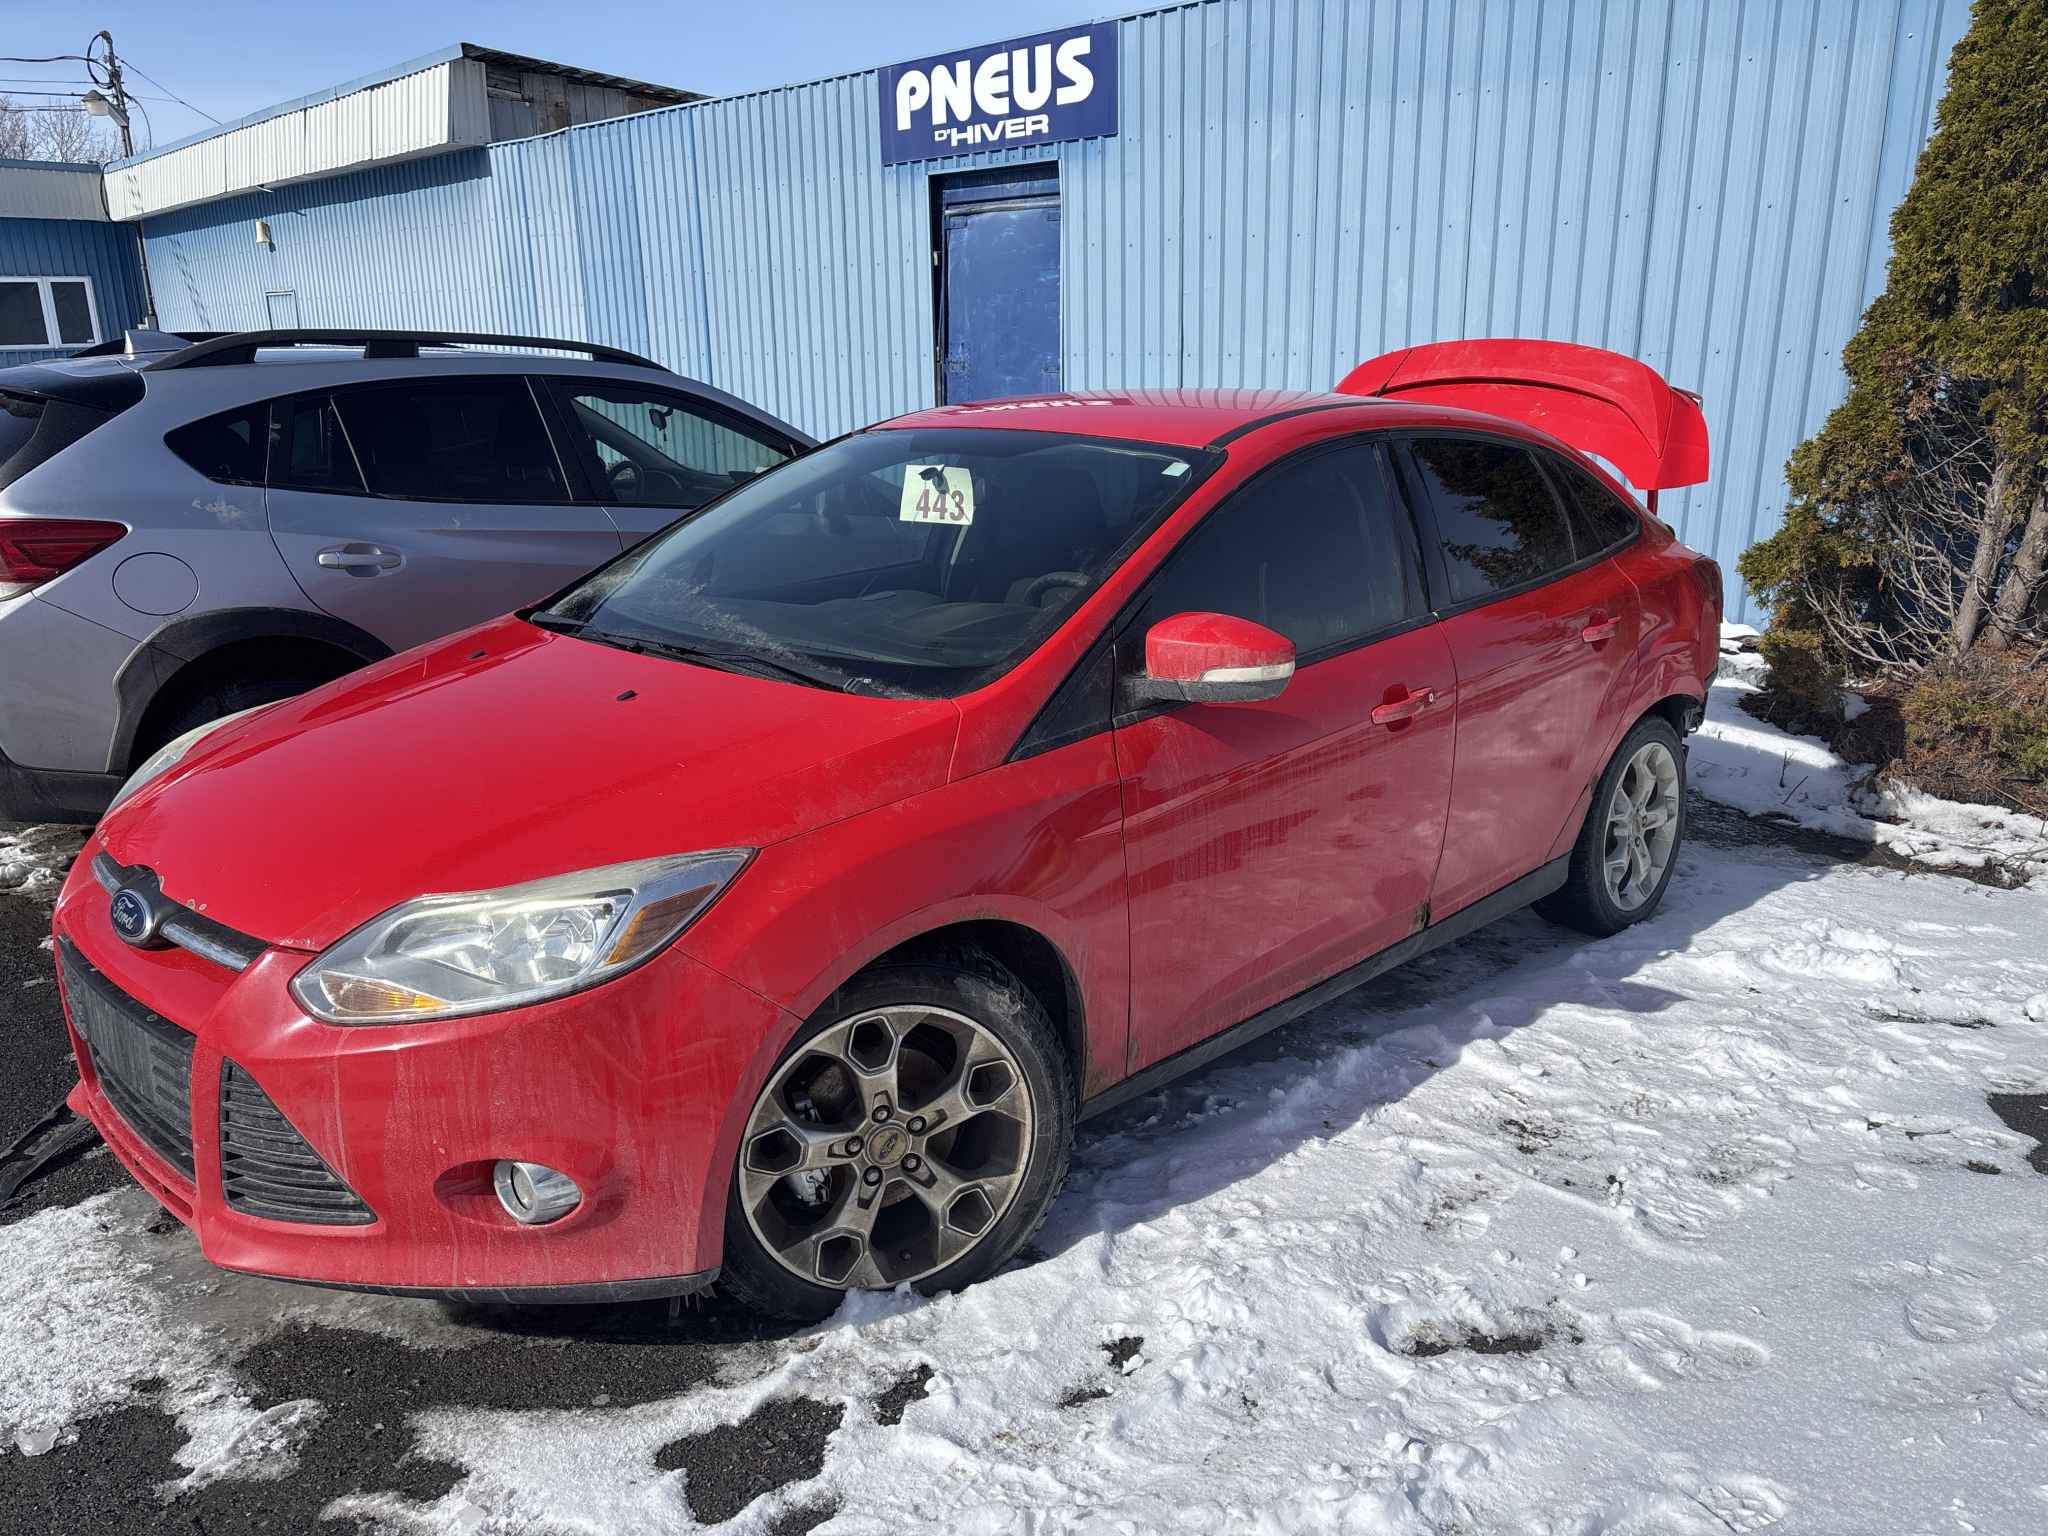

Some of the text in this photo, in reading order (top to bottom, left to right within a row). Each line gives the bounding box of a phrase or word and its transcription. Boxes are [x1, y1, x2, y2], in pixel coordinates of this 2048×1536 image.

[896, 35, 1094, 131] PNEUS
[934, 113, 1049, 147] D'HIVER
[916, 489, 965, 521] 443
[113, 896, 138, 930] Ford
